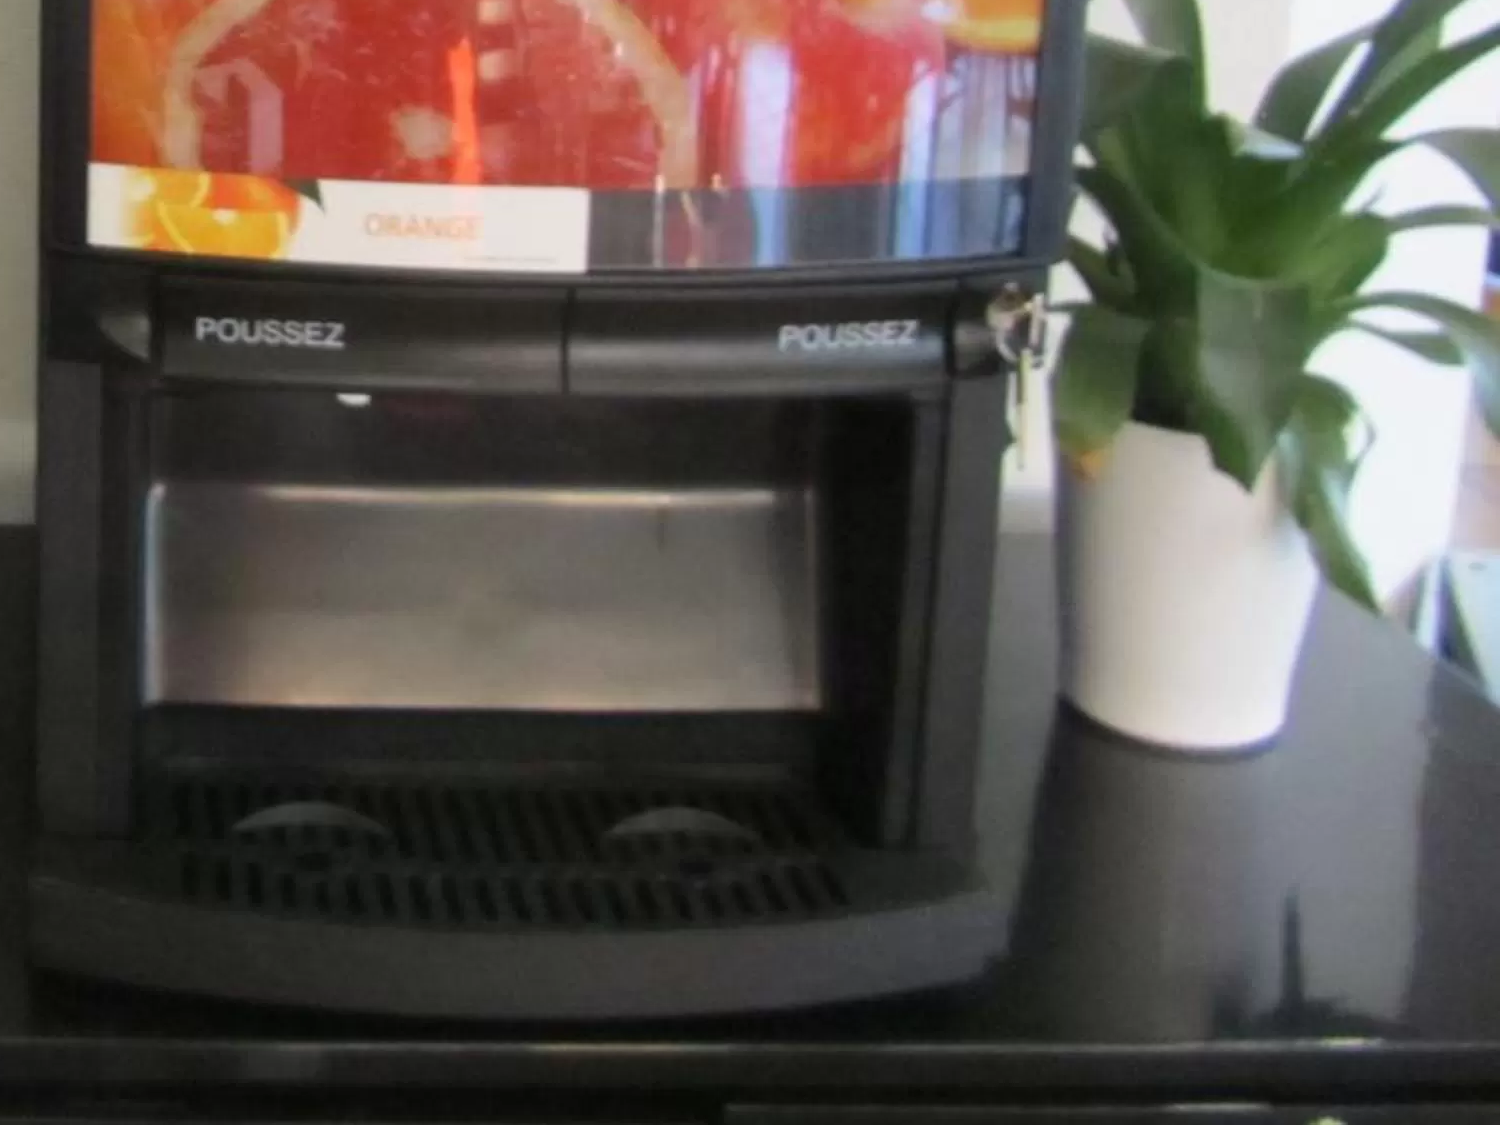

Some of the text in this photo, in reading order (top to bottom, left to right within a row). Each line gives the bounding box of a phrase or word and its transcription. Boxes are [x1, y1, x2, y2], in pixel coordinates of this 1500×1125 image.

[364, 213, 482, 241] ORANGE
[195, 316, 345, 349] POUSSEZ
[777, 319, 919, 353] POUSSEZ
